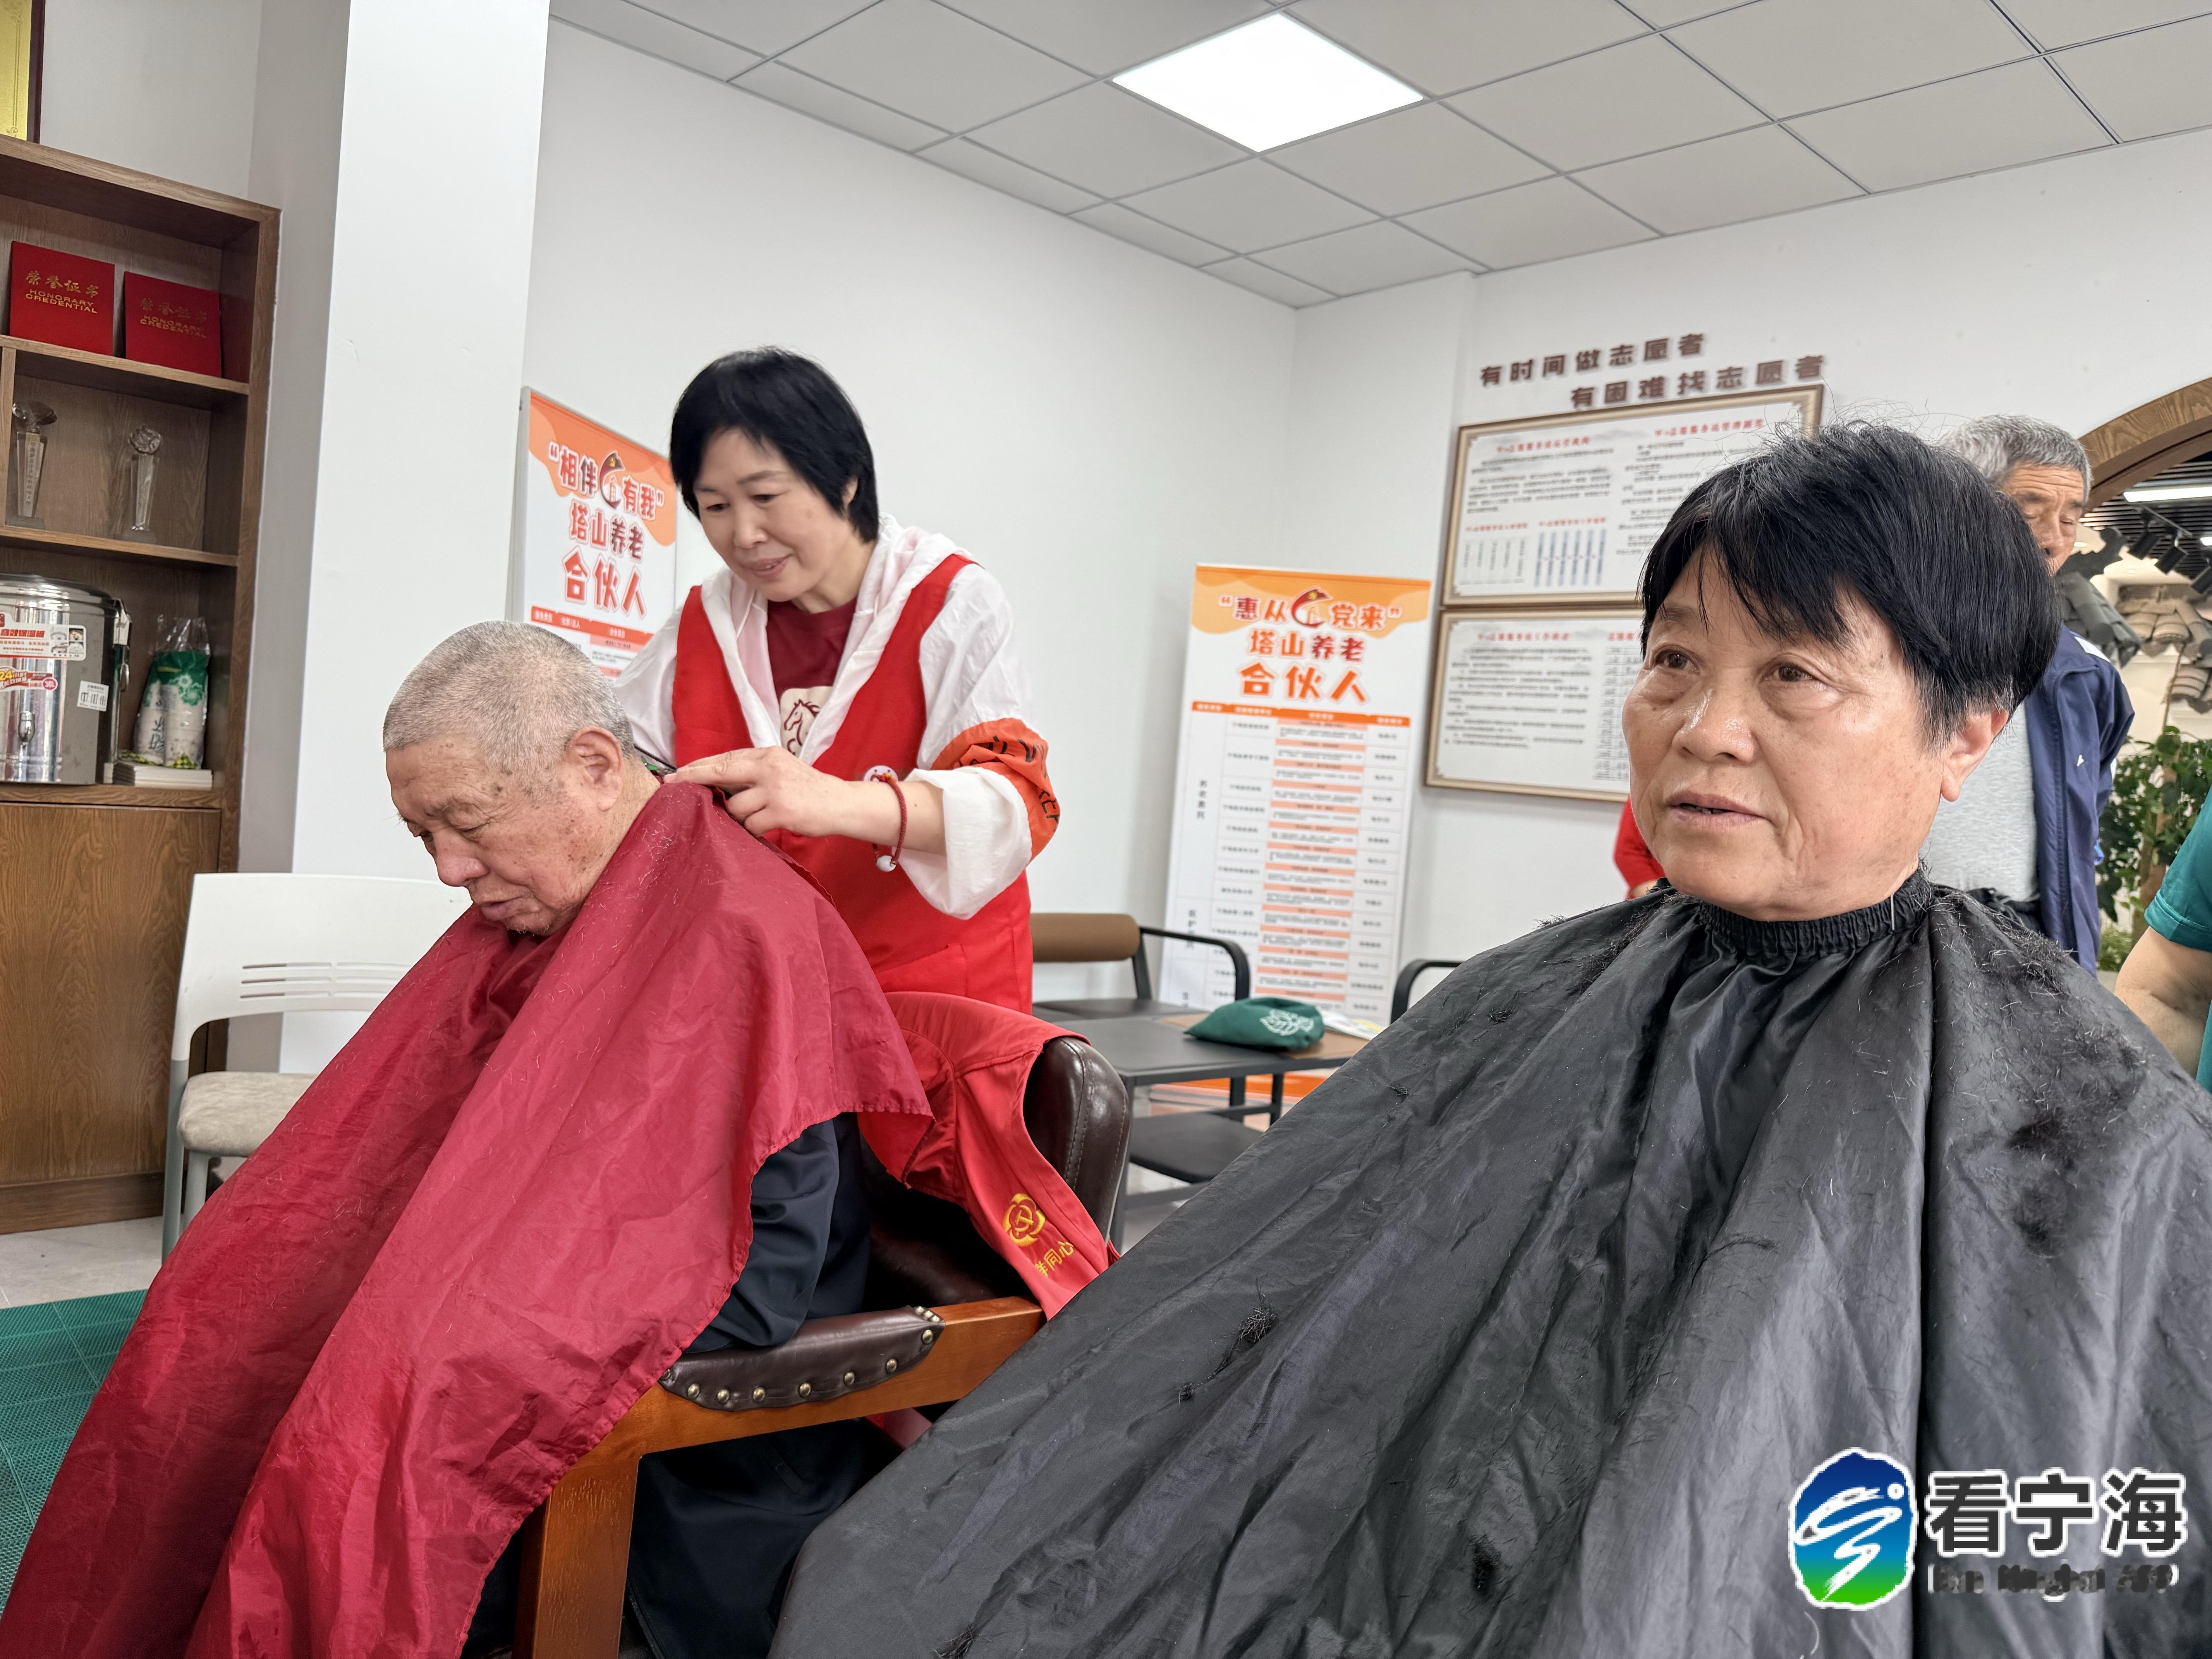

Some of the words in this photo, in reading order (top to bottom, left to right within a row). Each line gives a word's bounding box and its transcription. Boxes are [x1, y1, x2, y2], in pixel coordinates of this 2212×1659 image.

[26, 270, 98, 298] 荣誉证书
[26, 294, 97, 314] CREDENTIAL
[30, 289, 94, 307] HONORARY
[1479, 333, 1706, 387] 有时间做志愿者
[1571, 355, 1825, 408] 有困难找志愿者
[570, 500, 645, 563] 塔山养老
[564, 547, 646, 618] 合伙人
[1249, 628, 1365, 663] 塔山养老
[1238, 662, 1369, 705] 合伙人
